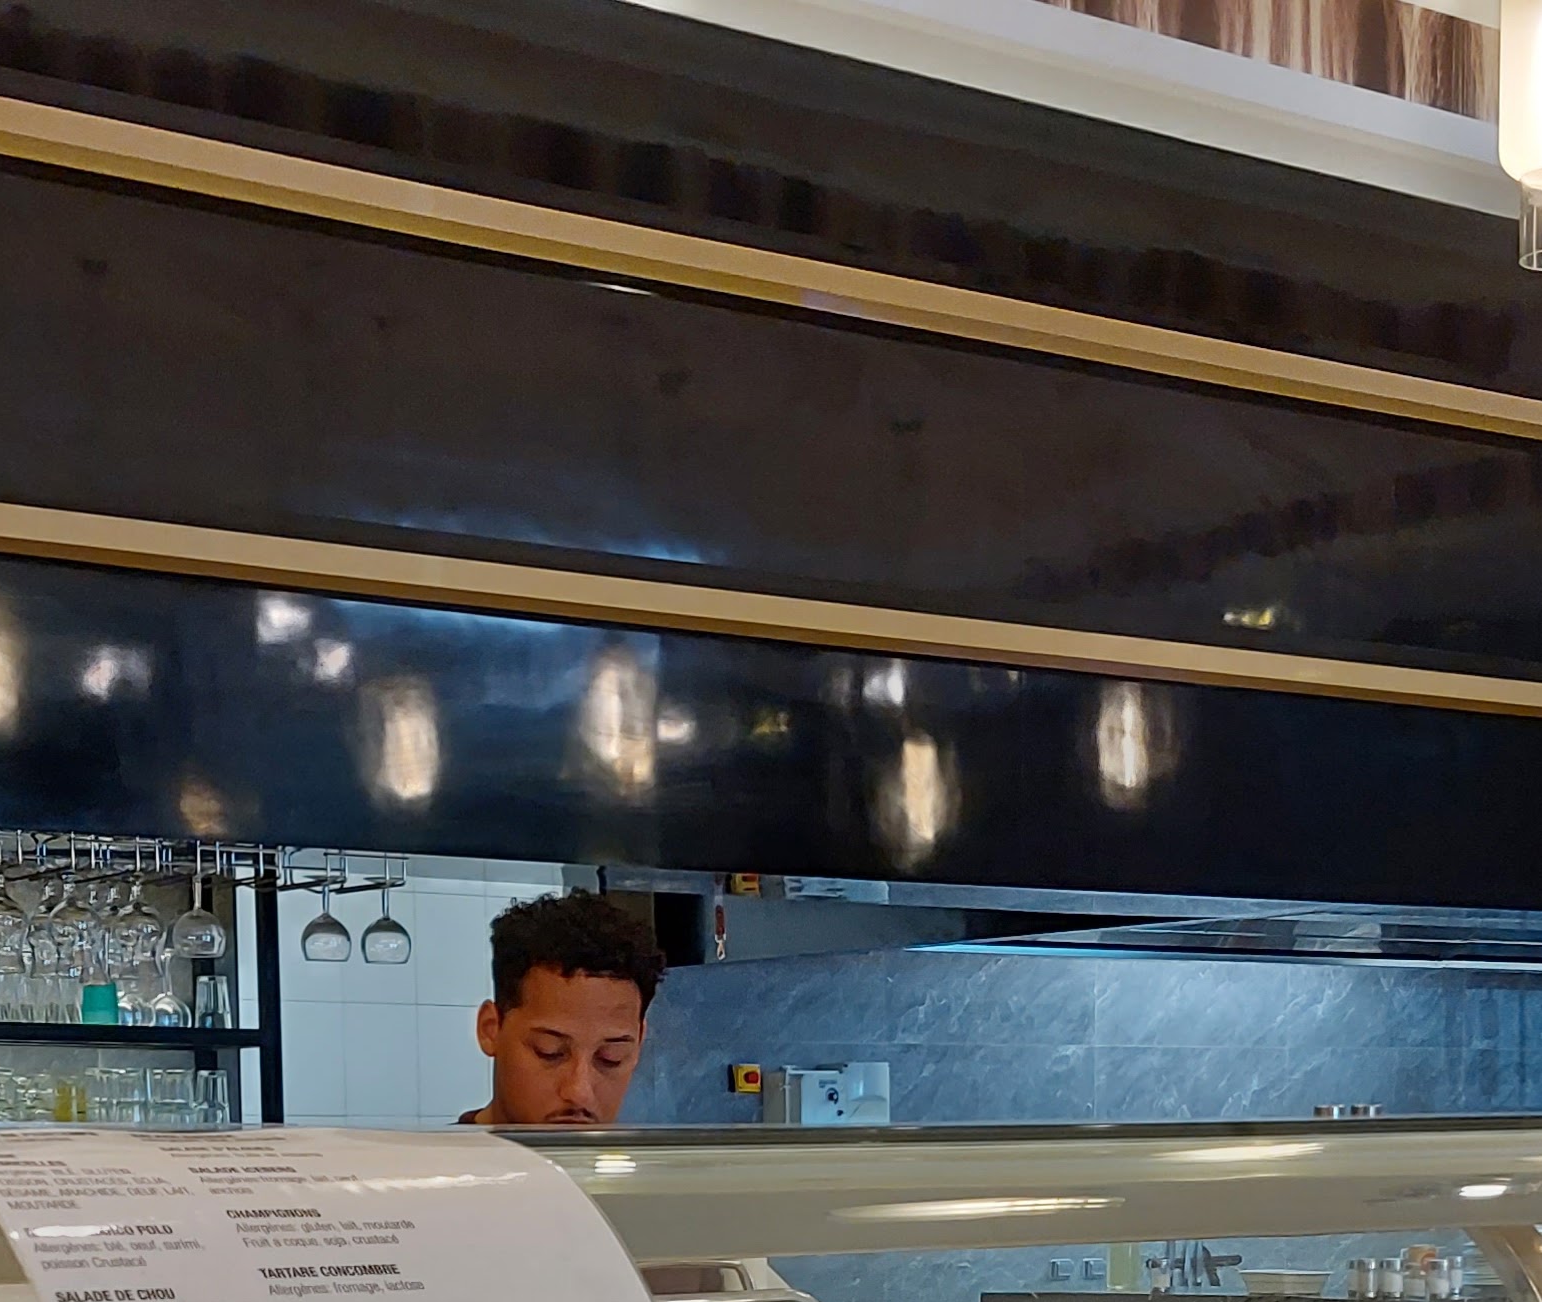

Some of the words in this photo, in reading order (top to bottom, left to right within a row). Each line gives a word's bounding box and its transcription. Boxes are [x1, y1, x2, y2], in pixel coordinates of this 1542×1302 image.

[225, 1207, 322, 1219] CHAMPIGNONS
[136, 1223, 175, 1236] POLO
[363, 1219, 416, 1230] moutarde
[41, 1258, 91, 1272] poisson
[257, 1266, 320, 1280] TARTARE
[319, 1263, 401, 1278] CONCOMBRE
[115, 1289, 133, 1301] DE
[136, 1287, 176, 1300] CHOU
